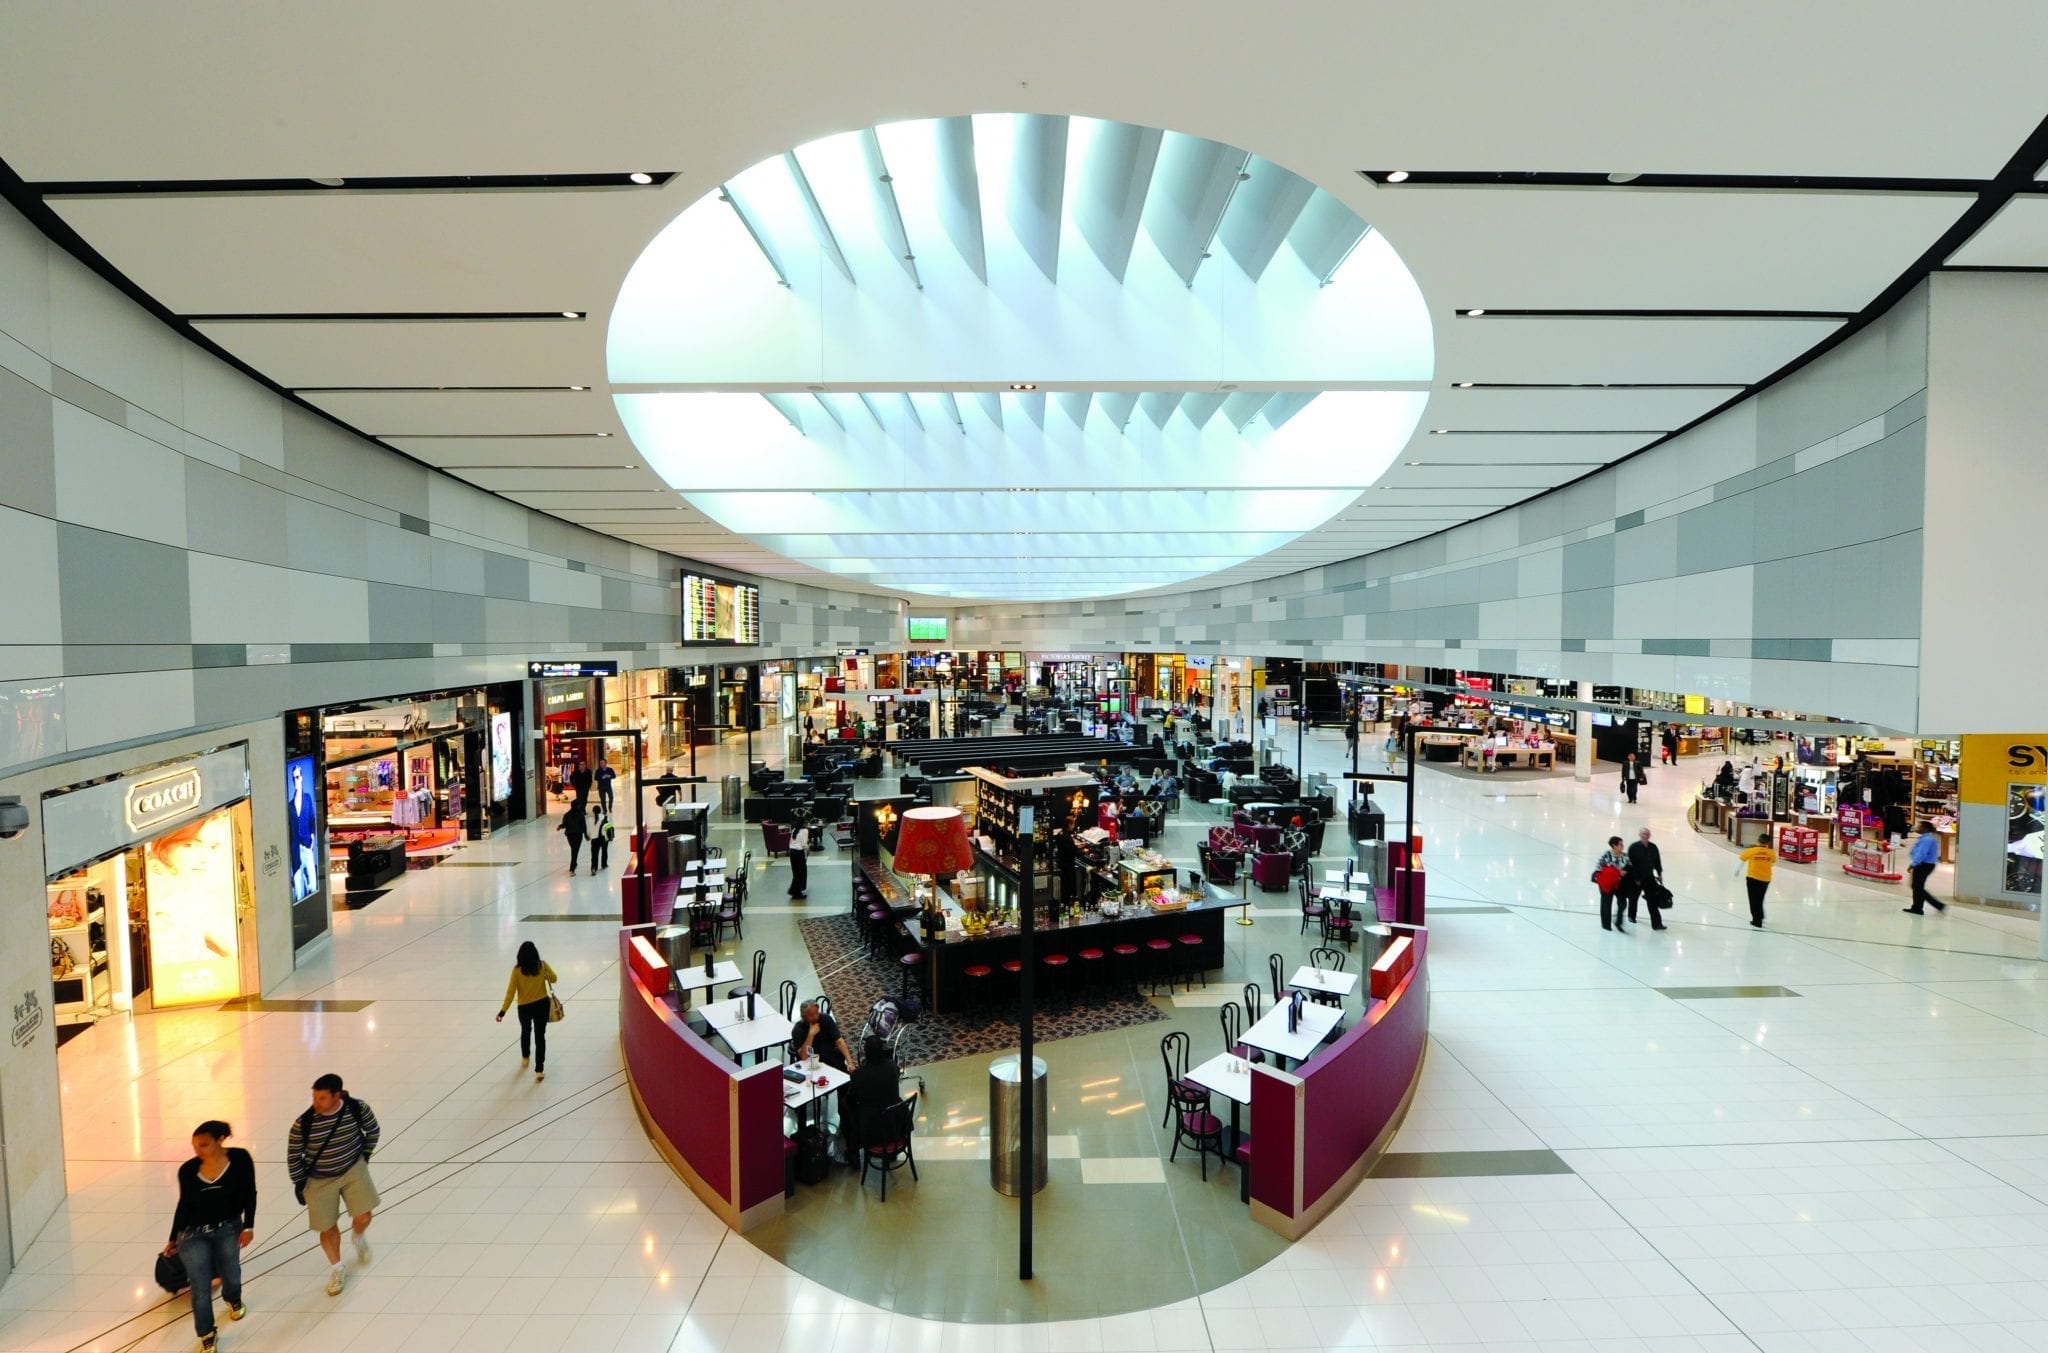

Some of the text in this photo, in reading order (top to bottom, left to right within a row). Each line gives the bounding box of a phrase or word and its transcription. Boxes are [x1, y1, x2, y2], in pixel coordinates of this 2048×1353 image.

[1627, 709, 1642, 717] FREE
[133, 781, 196, 814] COACH
[1841, 816, 1860, 824] OFFER
